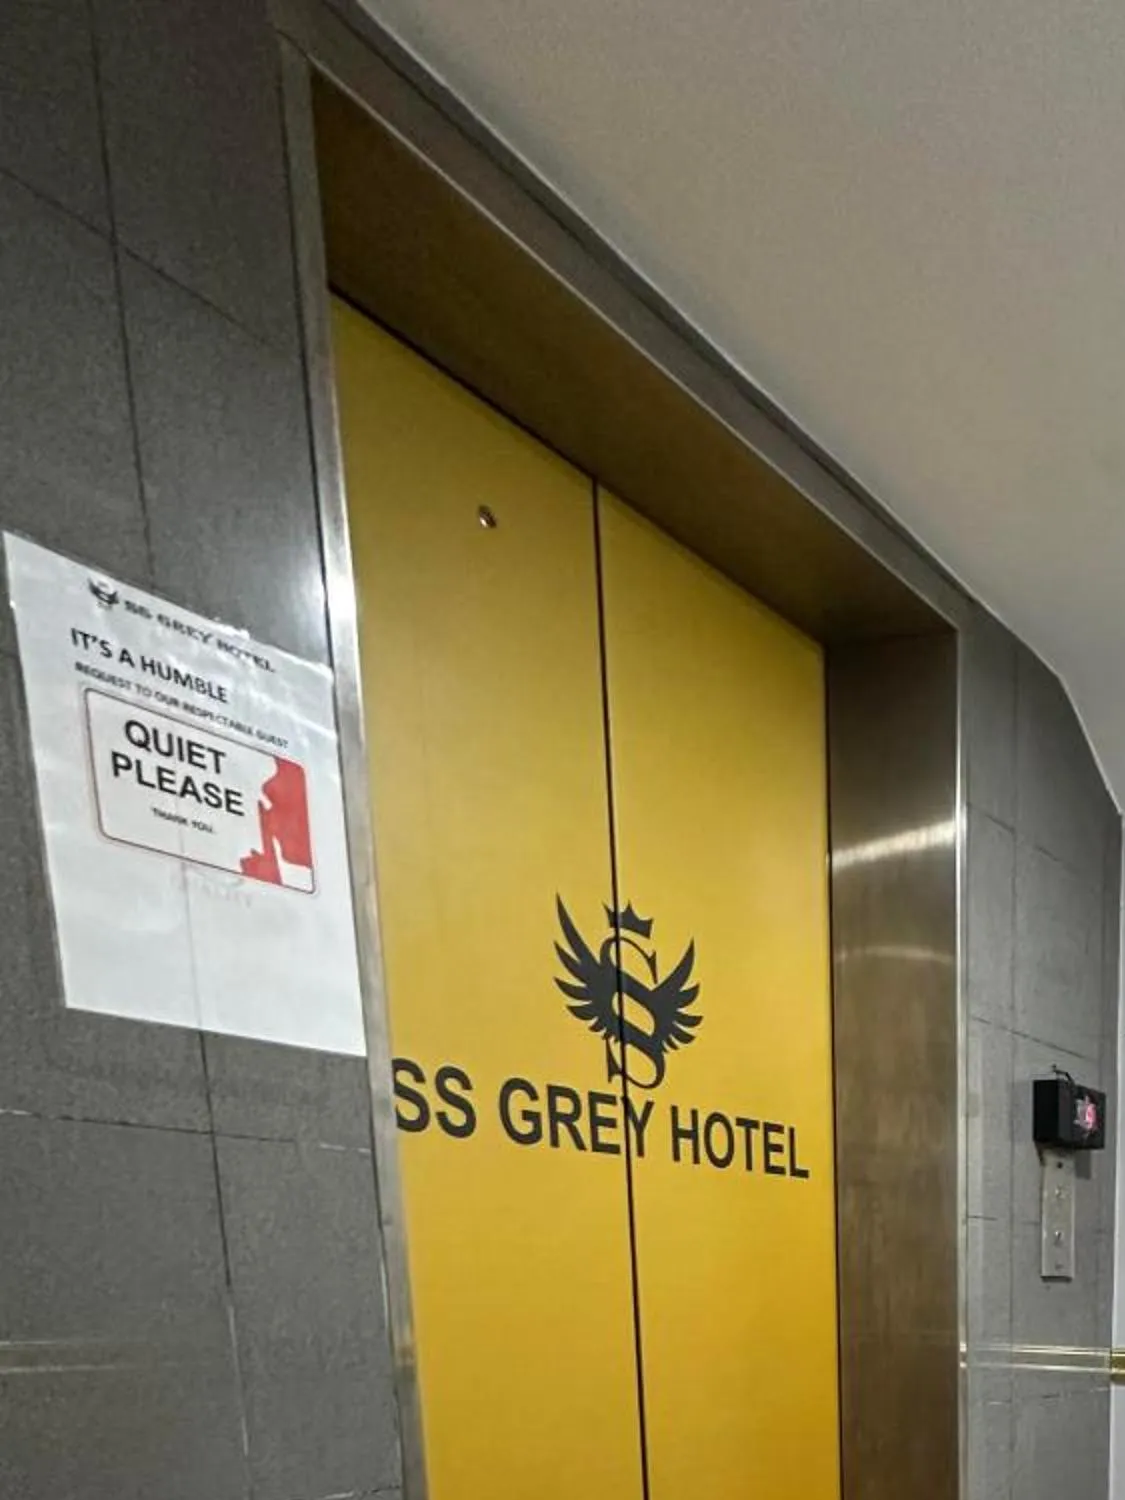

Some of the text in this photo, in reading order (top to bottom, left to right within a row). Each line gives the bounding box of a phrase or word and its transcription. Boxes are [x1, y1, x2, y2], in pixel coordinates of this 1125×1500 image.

[71, 627, 228, 704] IT'S A HUMBLE
[157, 613, 215, 644] GREY
[216, 638, 276, 673] HOTEL
[75, 661, 132, 690] REQUEST
[135, 683, 152, 697] TO
[154, 691, 179, 708] OUR
[255, 730, 289, 749] GUEST
[125, 719, 226, 774] QUIET
[111, 750, 245, 817] PLEASE
[151, 806, 188, 826] THANK
[391, 1057, 810, 1179] SS GREY HOTEL
